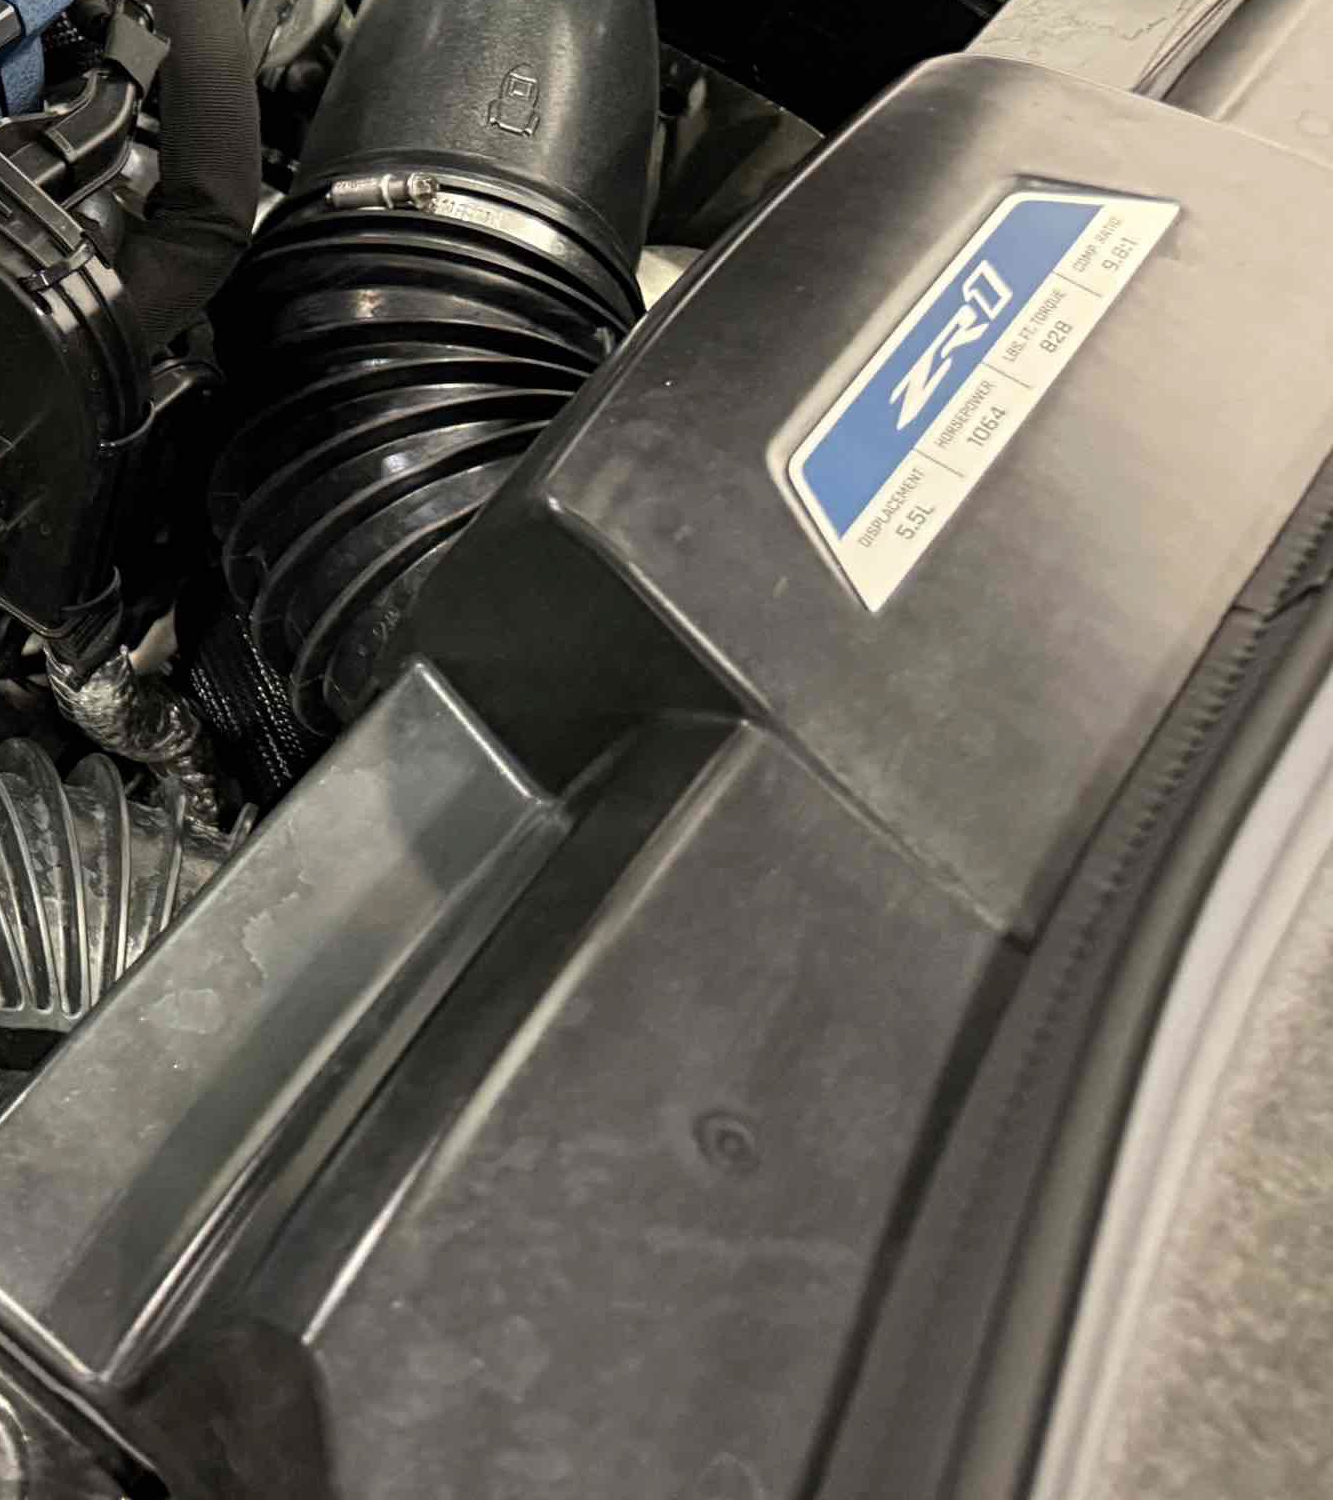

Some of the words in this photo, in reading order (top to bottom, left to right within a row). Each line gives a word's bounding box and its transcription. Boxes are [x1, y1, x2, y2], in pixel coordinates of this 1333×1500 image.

[1094, 216, 1123, 245] RATIO
[1100, 236, 1140, 272] 9.8:1
[1030, 287, 1067, 326] TORQUE
[888, 259, 1014, 431] ZR1
[1039, 319, 1074, 354] 828
[934, 380, 995, 450] HORSEPOWER
[966, 405, 1007, 449] 1064
[857, 466, 927, 548] DISPLACEMENT
[894, 503, 938, 541] 5.5L
